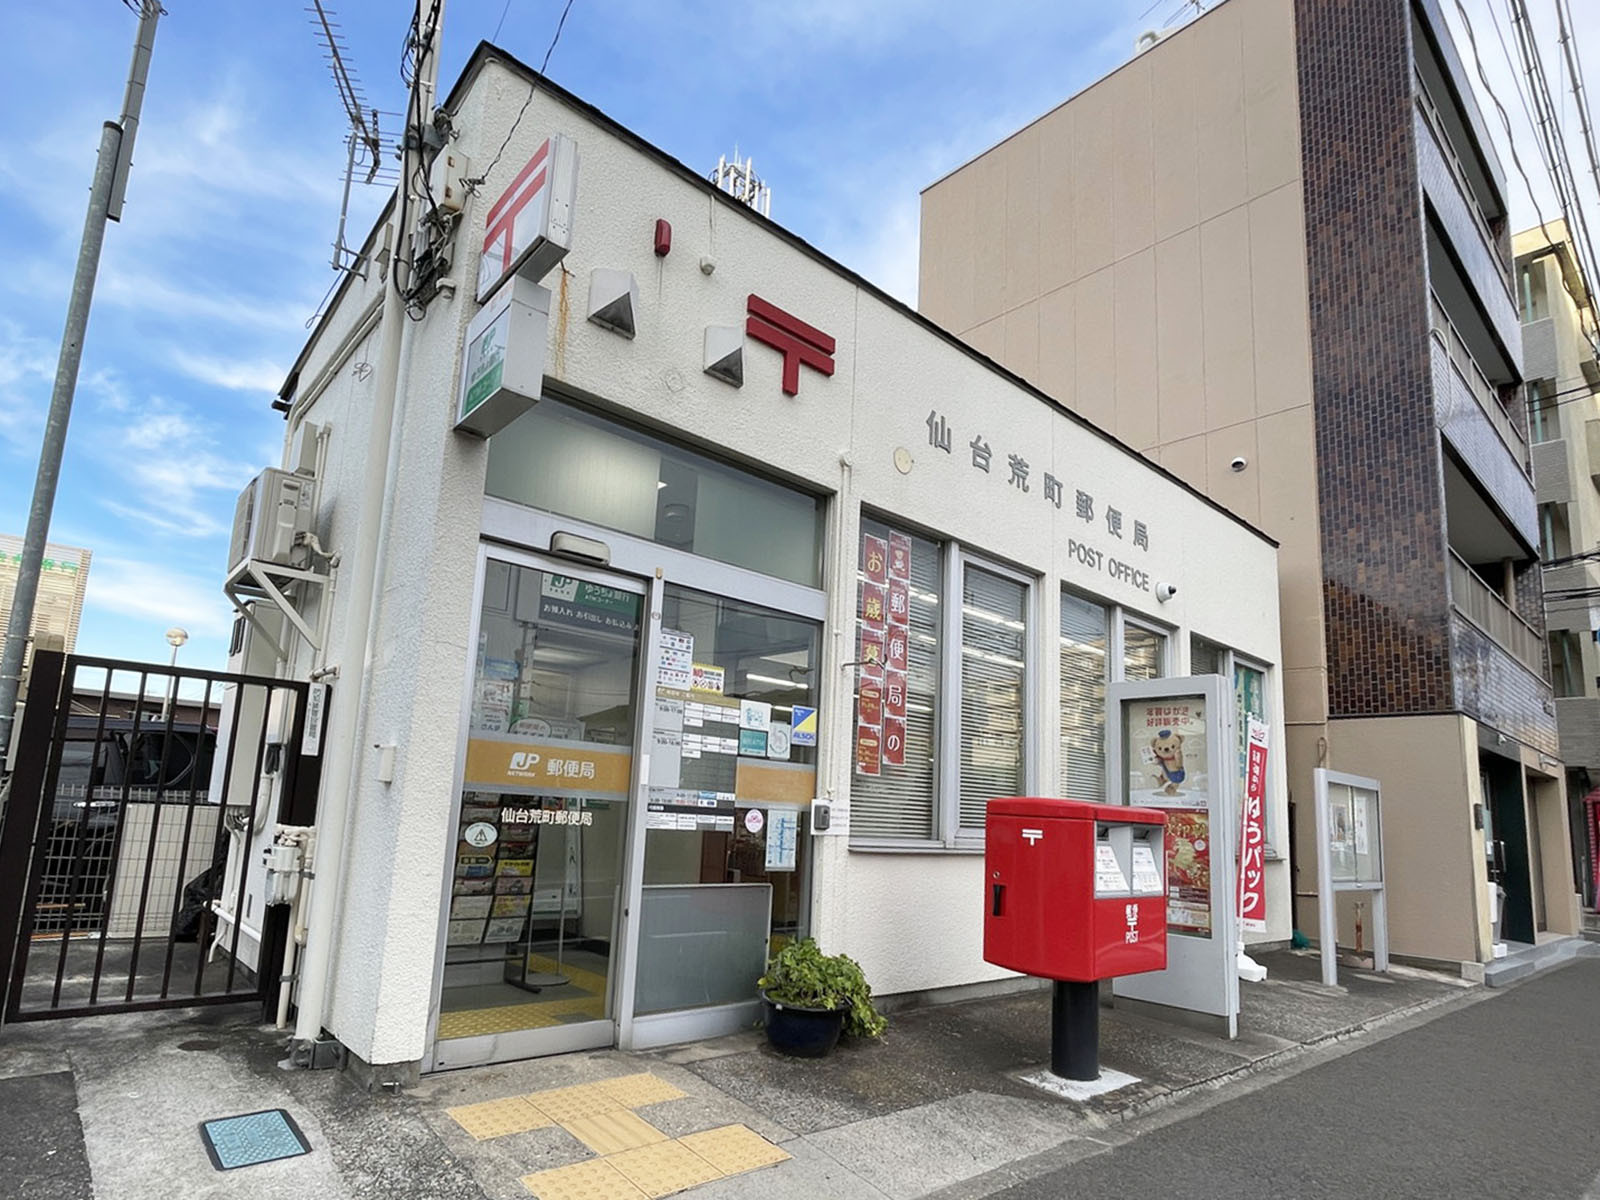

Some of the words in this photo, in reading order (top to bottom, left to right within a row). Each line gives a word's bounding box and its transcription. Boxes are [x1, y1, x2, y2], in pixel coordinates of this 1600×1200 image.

[926, 410, 1149, 552] 仙台荒町郵便局
[1068, 538, 1103, 571] POST
[1107, 557, 1149, 592] OFFICE
[546, 758, 595, 780] 郵便局
[501, 807, 593, 827] 仙台荒町郵便局
